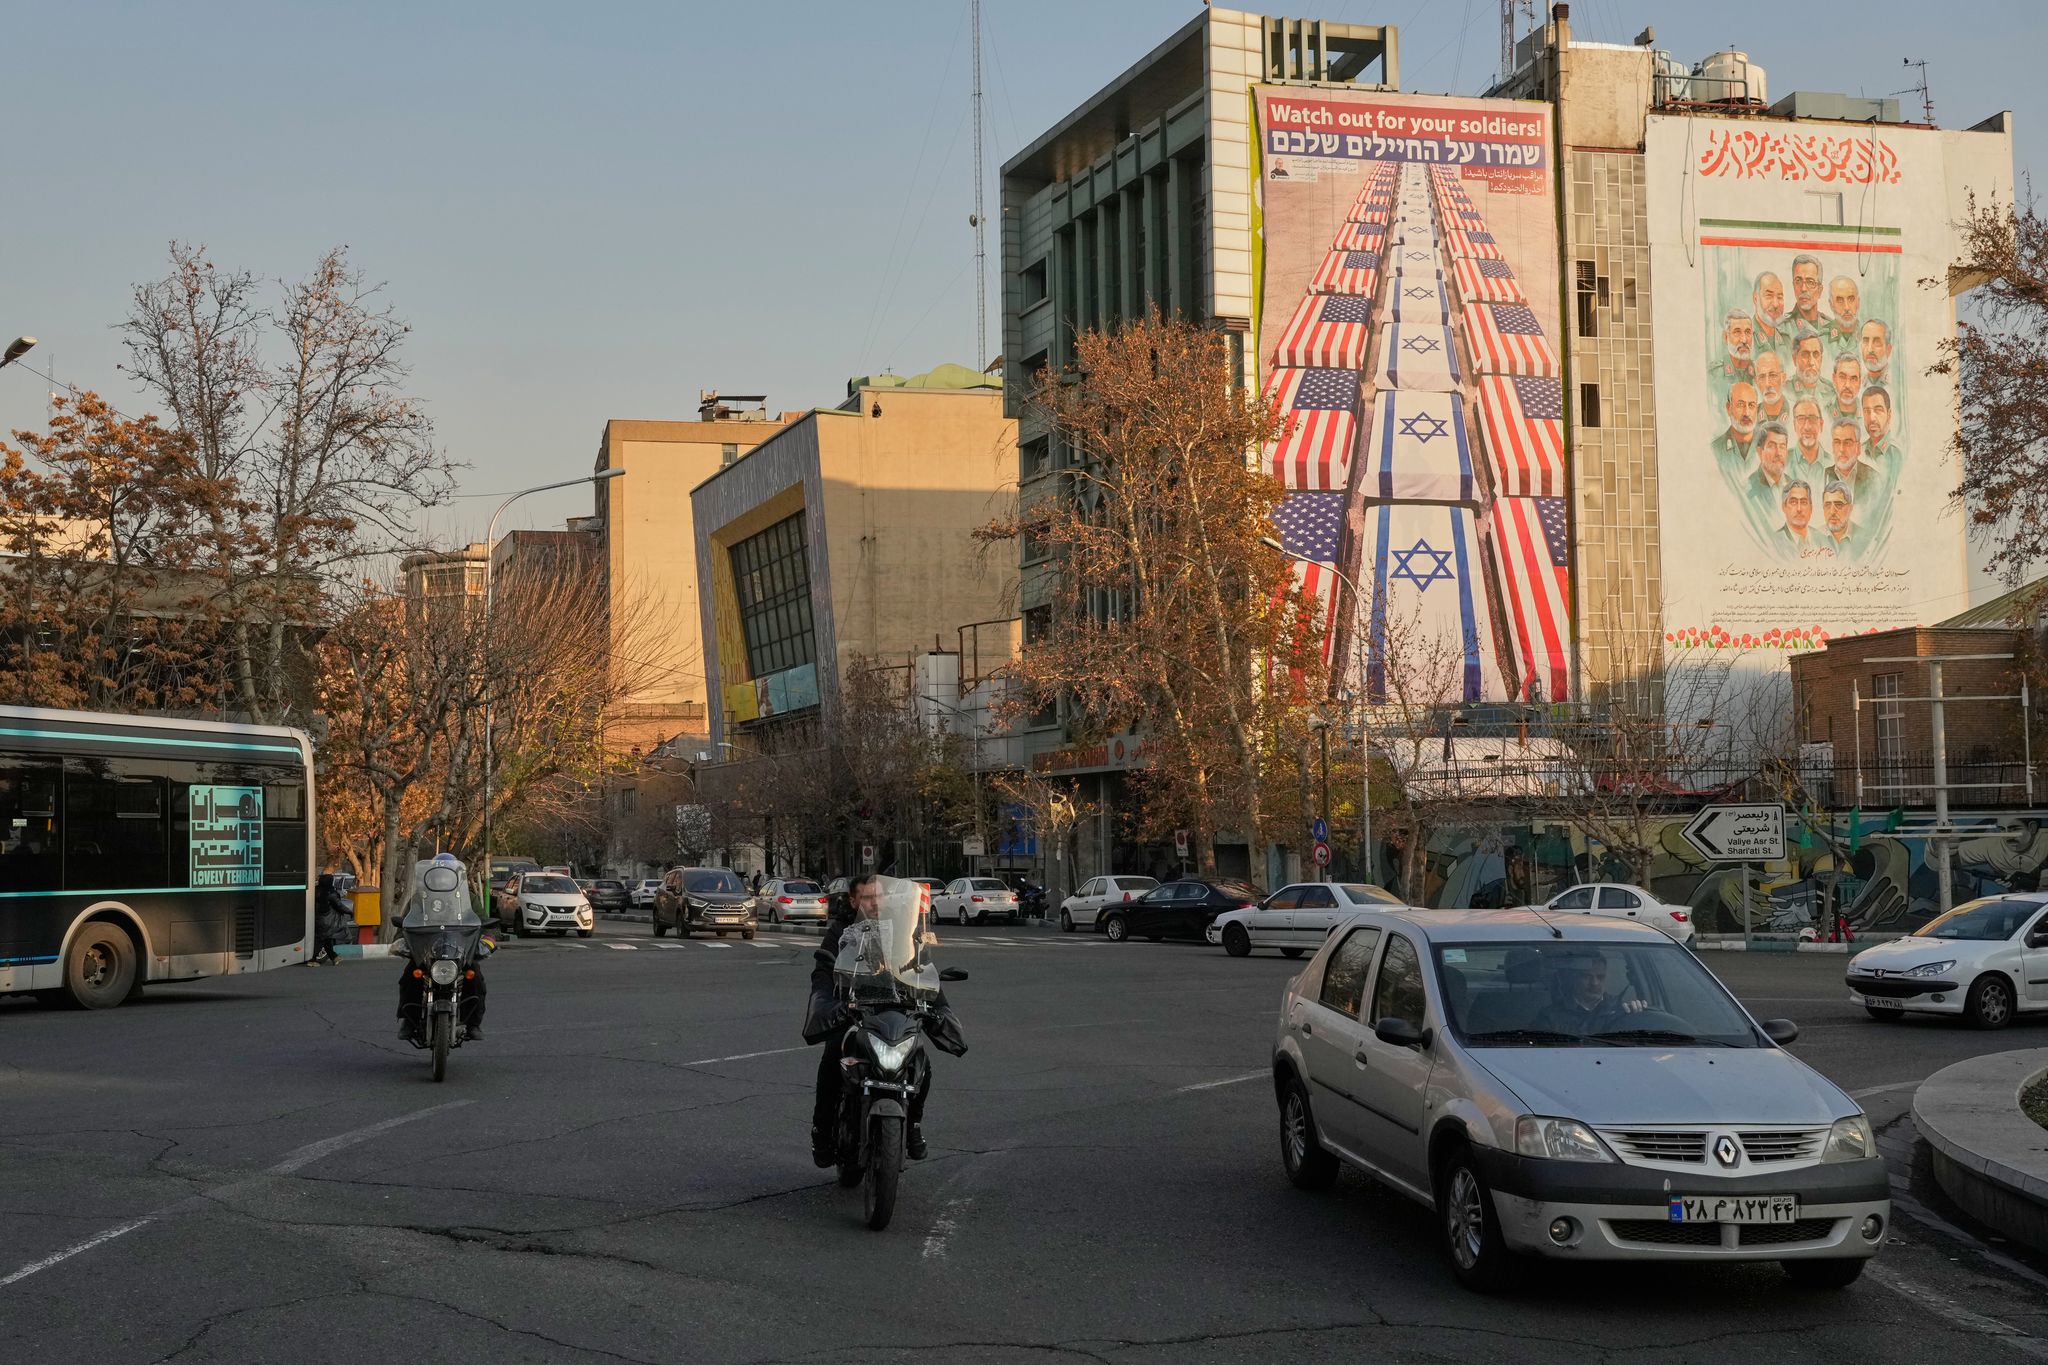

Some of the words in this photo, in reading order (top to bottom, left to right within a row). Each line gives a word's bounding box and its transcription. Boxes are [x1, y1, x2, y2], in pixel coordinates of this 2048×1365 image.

[1270, 104, 1334, 125] Watch
[1338, 111, 1373, 128] out
[1376, 110, 1406, 130] for
[1410, 117, 1456, 135] your
[1460, 116, 1542, 137] soldiers!
[1272, 126, 1340, 154] שלכם
[1346, 130, 1440, 160] החיילים
[1445, 134, 1476, 164] על
[1481, 142, 1540, 165] שמרו
[1734, 824, 1770, 835] شریعتی
[1728, 838, 1752, 846] Valiye
[193, 870, 225, 885] LOVELY
[226, 870, 260, 884] TEHRAN
[1684, 1200, 1708, 1220] ۲۸
[1733, 1200, 1768, 1220] ۸۲۳
[1772, 1203, 1793, 1221] ۴۴
